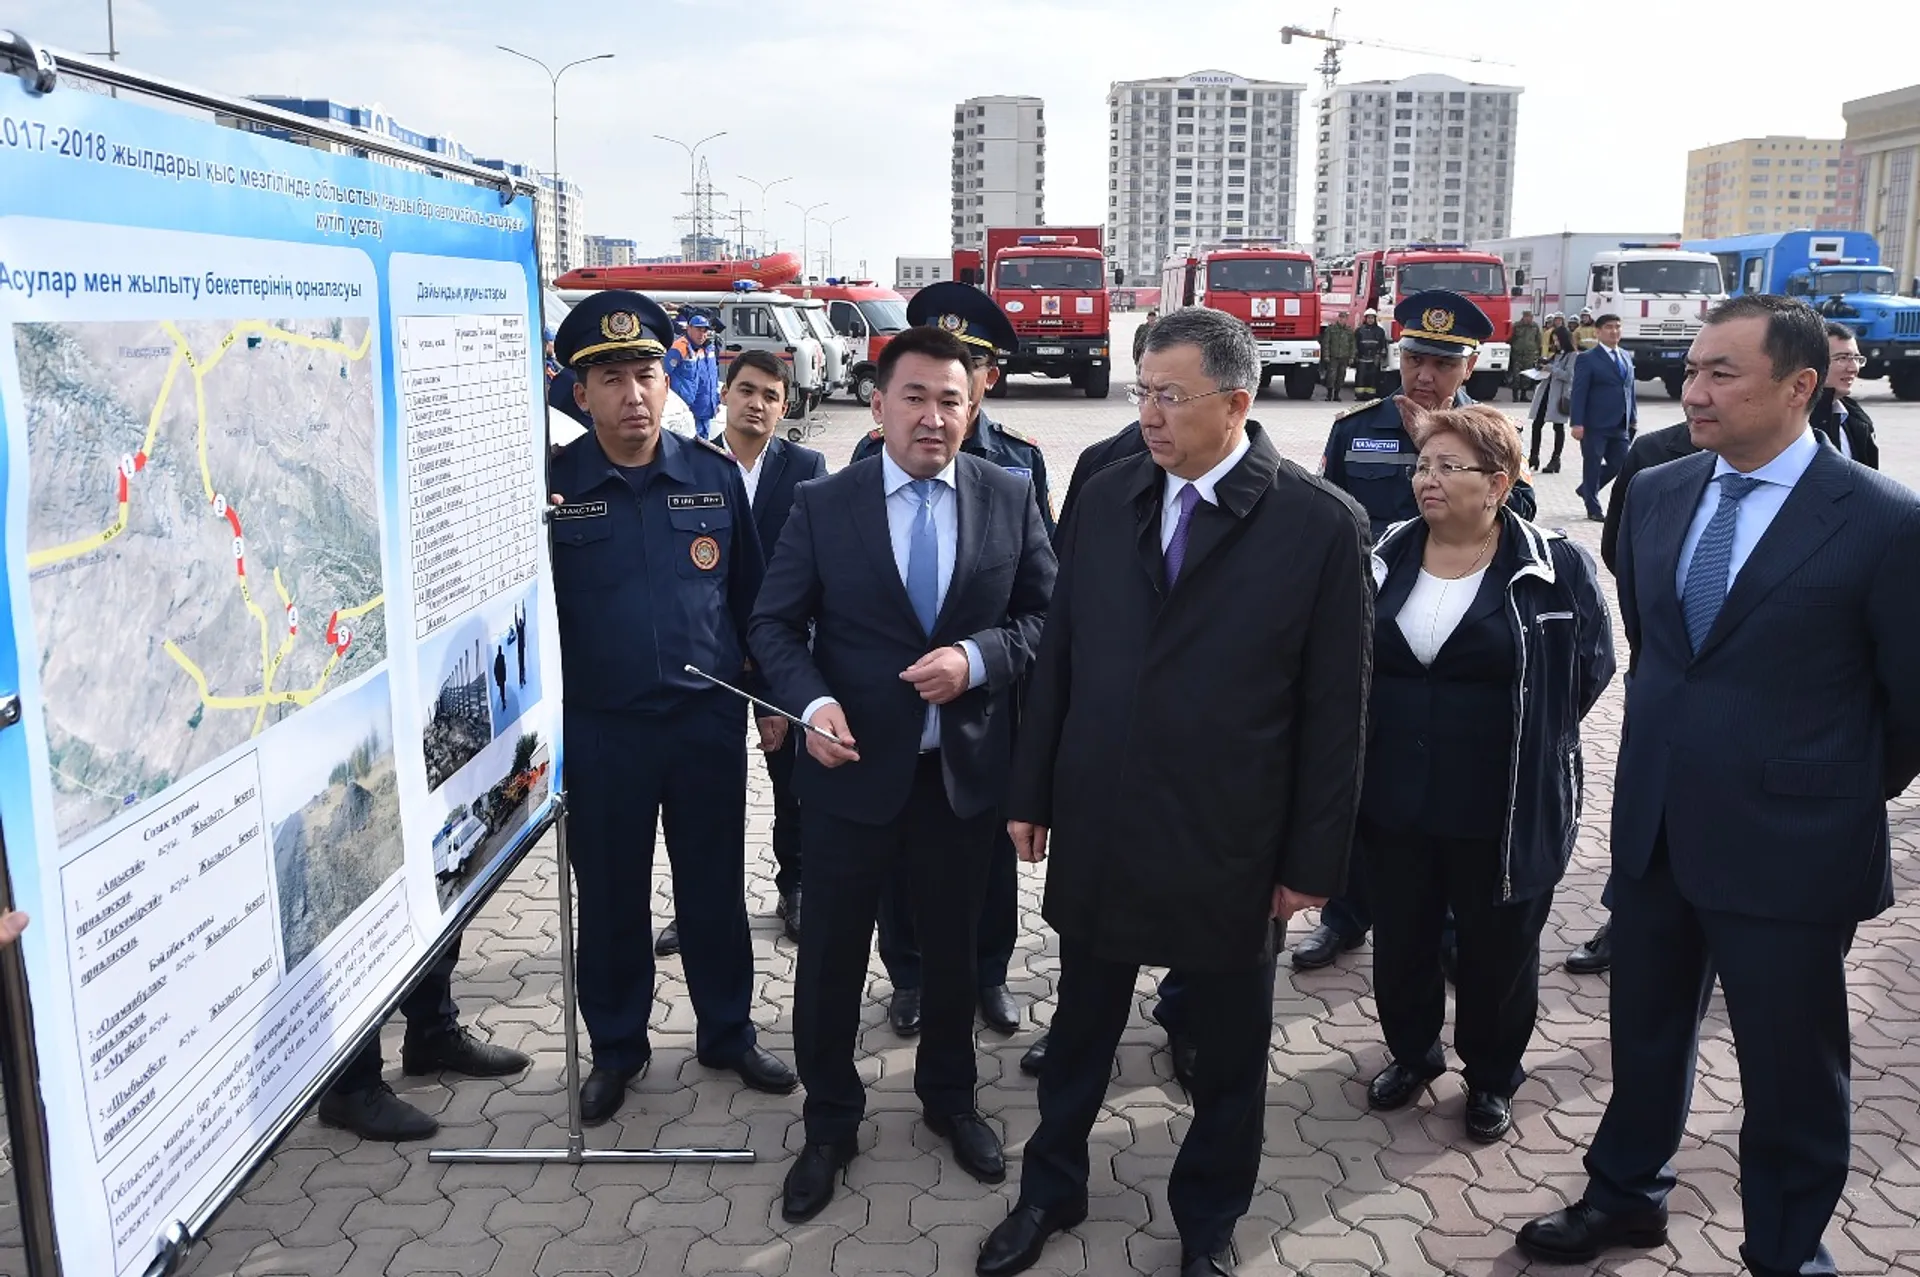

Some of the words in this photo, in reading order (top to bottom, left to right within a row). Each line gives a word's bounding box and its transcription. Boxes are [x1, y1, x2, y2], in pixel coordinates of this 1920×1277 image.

[112, 144, 201, 181] жылдары
[206, 161, 235, 184] қыс
[240, 169, 311, 198] мезгілінде
[0, 261, 77, 298] Асулар
[84, 272, 122, 292] мен
[128, 274, 200, 301] жылыту
[205, 272, 294, 300] бекеттерінің
[296, 281, 362, 302] орналасуы
